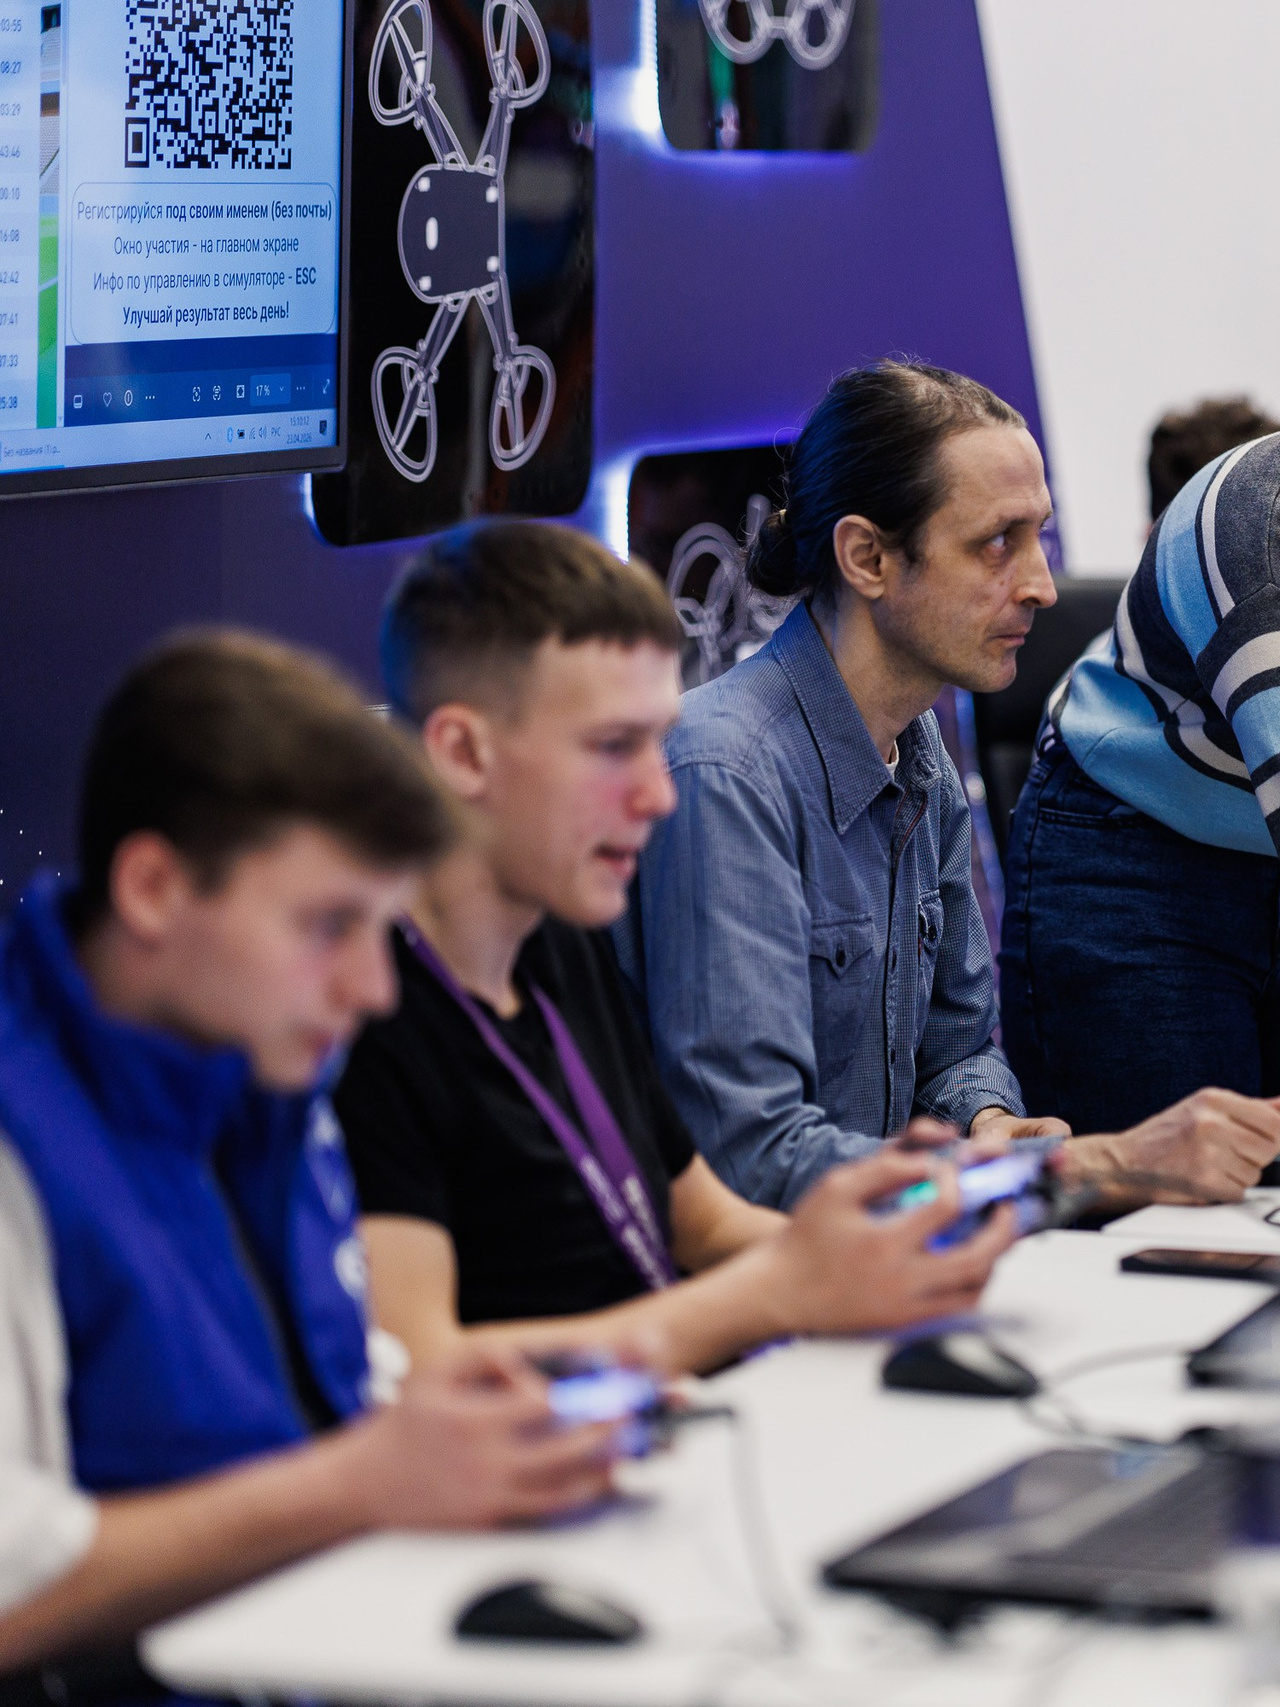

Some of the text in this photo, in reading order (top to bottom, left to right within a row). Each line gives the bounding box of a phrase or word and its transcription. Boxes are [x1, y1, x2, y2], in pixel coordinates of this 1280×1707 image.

[77, 201, 332, 223] Регистрируйся под своим именем (без почты)
[114, 237, 142, 254] Окно
[145, 238, 189, 258] участия
[200, 239, 213, 253] на
[216, 238, 260, 252] главном
[263, 237, 299, 256] экране
[93, 272, 124, 294] Инфо
[127, 275, 140, 290] по
[143, 273, 211, 293] управлению
[214, 273, 220, 287] в
[223, 271, 285, 290] симуляторе
[295, 267, 317, 285] ESC
[122, 301, 290, 328] Улучшай результат весь день!
[255, 384, 271, 396] 17%
